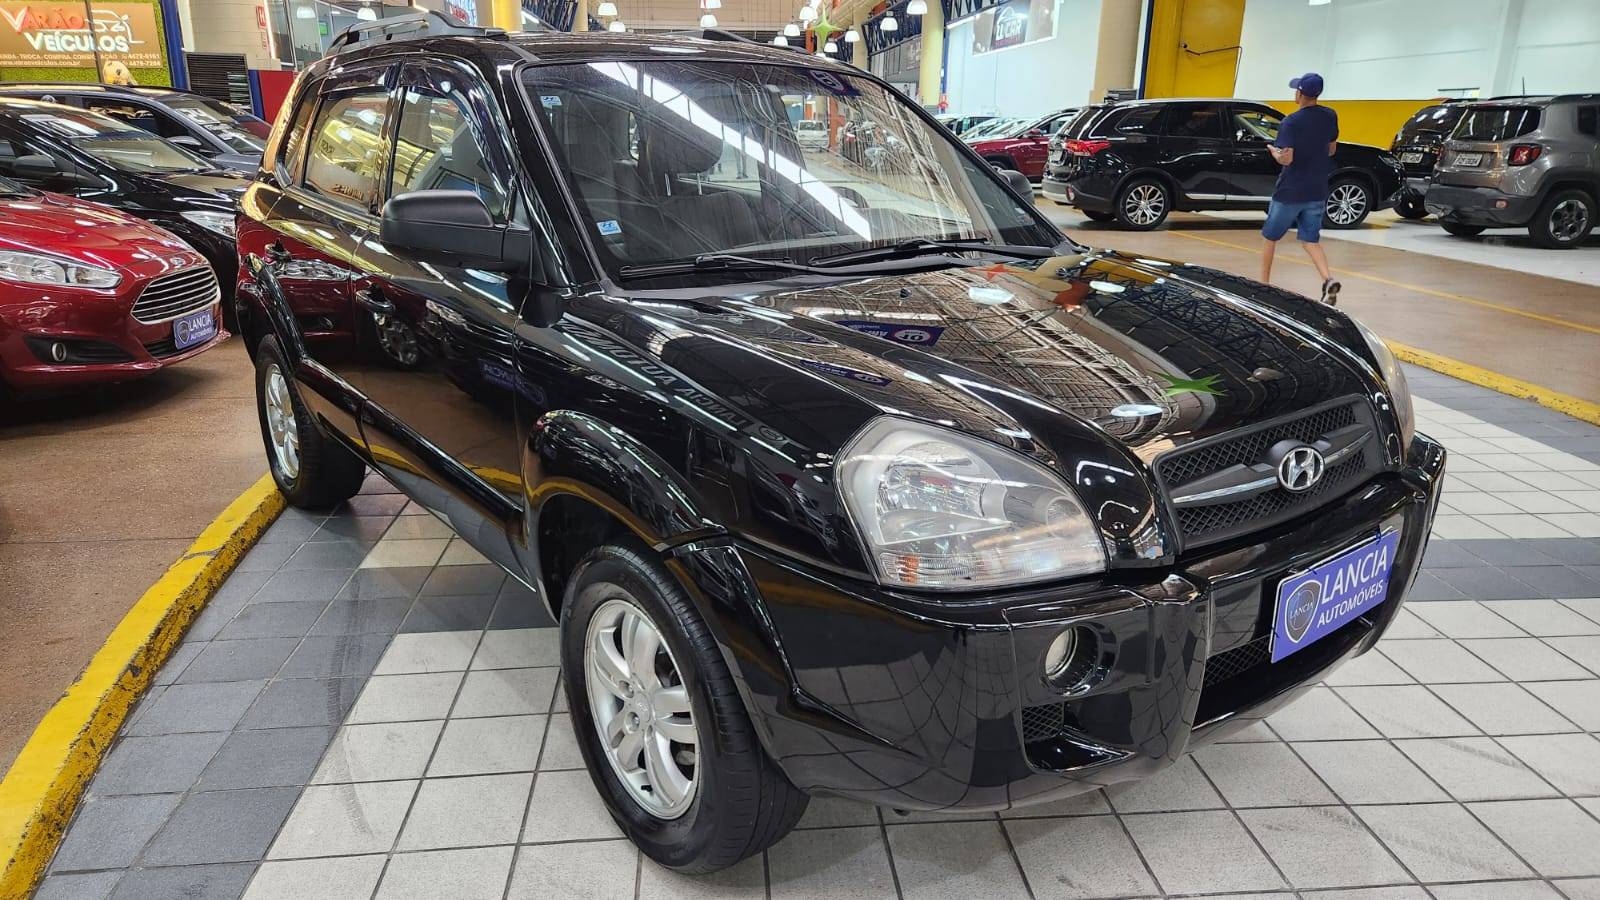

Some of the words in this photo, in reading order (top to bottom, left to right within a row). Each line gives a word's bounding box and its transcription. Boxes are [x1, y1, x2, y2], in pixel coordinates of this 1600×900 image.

[23, 31, 129, 52] VEÍCULOS
[1322, 545, 1388, 605] LANCIA
[1317, 578, 1384, 628] AUTOMÓVEIS
